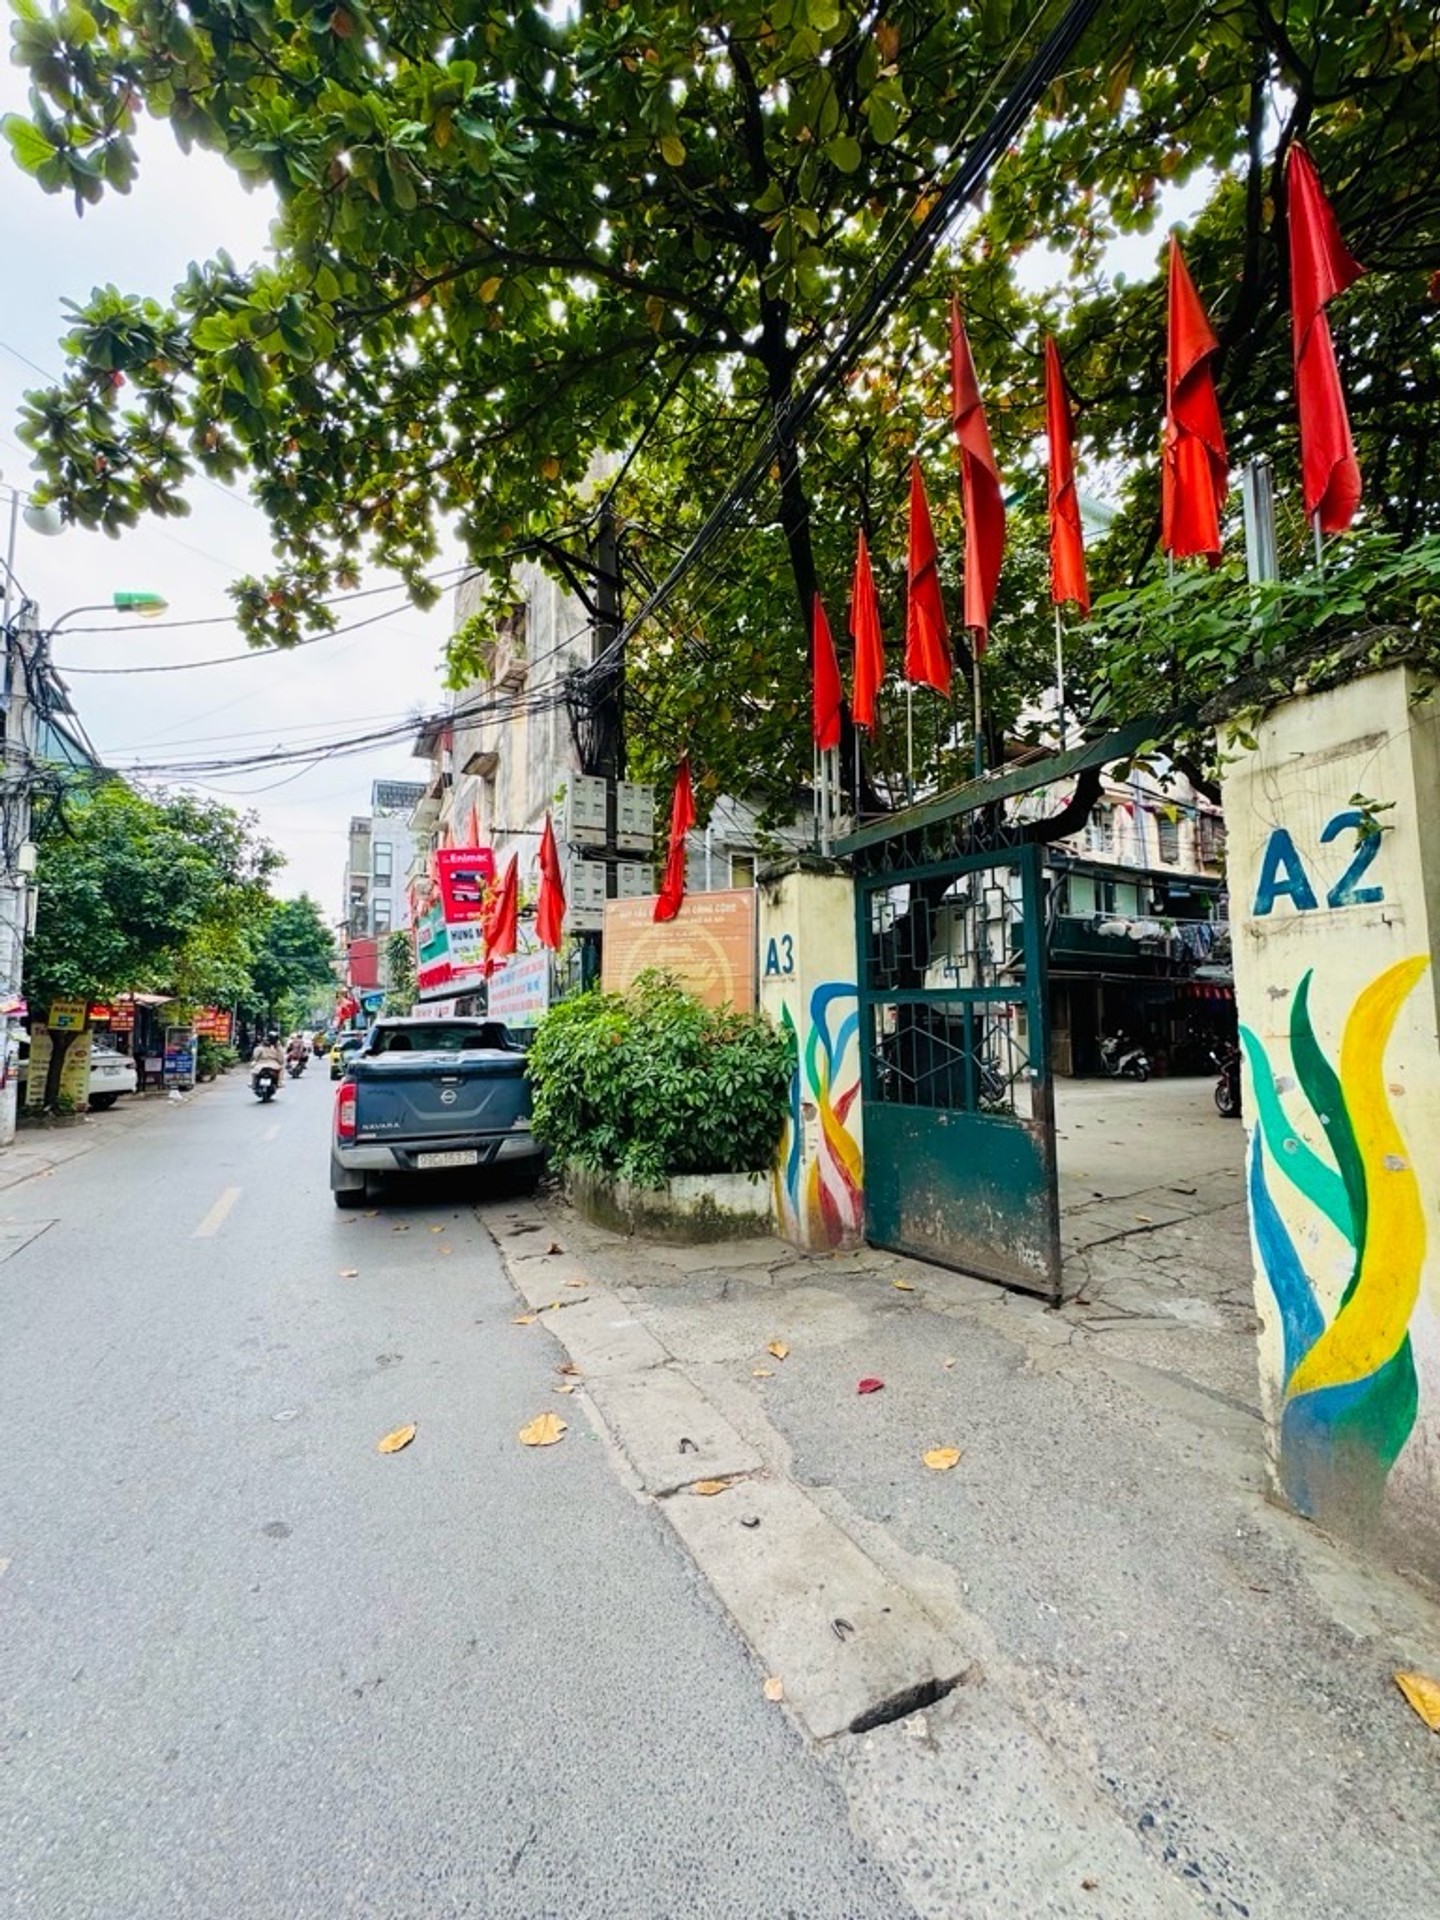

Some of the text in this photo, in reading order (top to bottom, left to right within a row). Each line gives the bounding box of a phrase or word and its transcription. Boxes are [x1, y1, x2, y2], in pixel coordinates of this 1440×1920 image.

[1252, 809, 1385, 916] A2
[765, 933, 794, 976] A3
[362, 1122, 401, 1130] NAVARA
